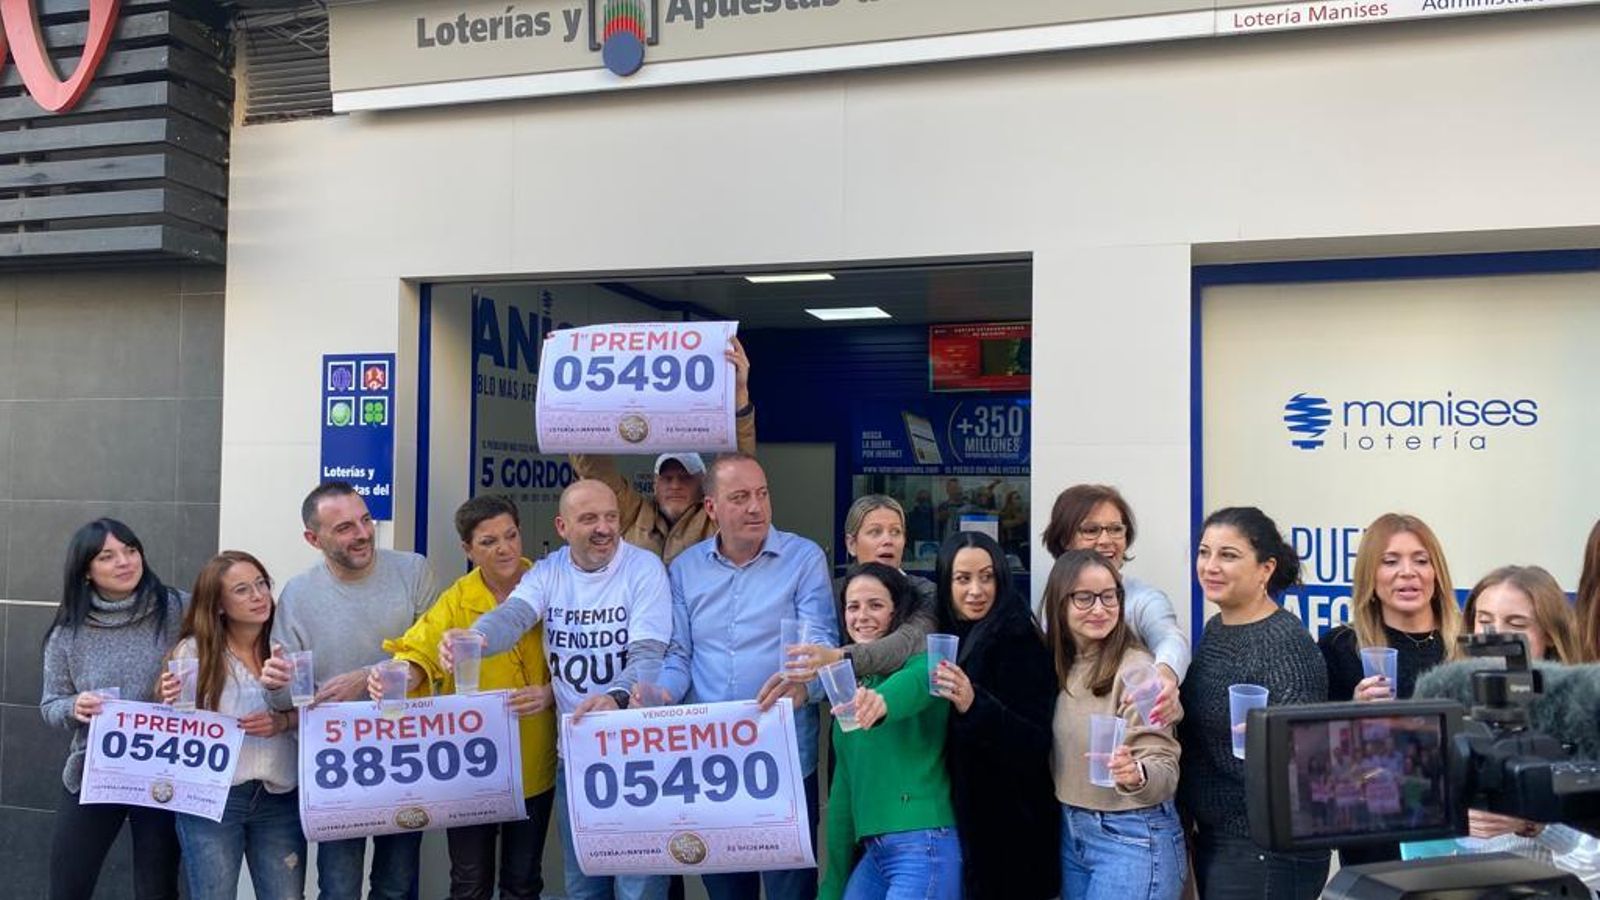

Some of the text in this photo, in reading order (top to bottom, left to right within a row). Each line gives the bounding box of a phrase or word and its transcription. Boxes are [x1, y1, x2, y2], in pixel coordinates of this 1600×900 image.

[417, 5, 551, 48] Loterías
[562, 8, 582, 43] y
[1234, 8, 1301, 29] Lotería
[1308, 2, 1388, 23] Manises
[591, 330, 703, 352] PREMIO
[553, 354, 715, 392] 05490
[957, 405, 1023, 438] +350
[1343, 391, 1538, 427] manises
[965, 437, 1020, 452] MILLONES
[1344, 431, 1486, 450] lotería
[324, 466, 376, 481] Loterías y
[481, 456, 579, 489] 5 GORDO
[373, 483, 390, 496] del
[1291, 527, 1367, 583] PUE
[565, 606, 627, 625] PREMIO
[547, 628, 629, 649] VENDIDO
[134, 713, 224, 739] PREMIO
[354, 710, 484, 742] PREMIO
[621, 719, 758, 756] PREMIO
[102, 730, 230, 772] 05490
[315, 736, 498, 790] 88509
[584, 750, 779, 810] 05490
